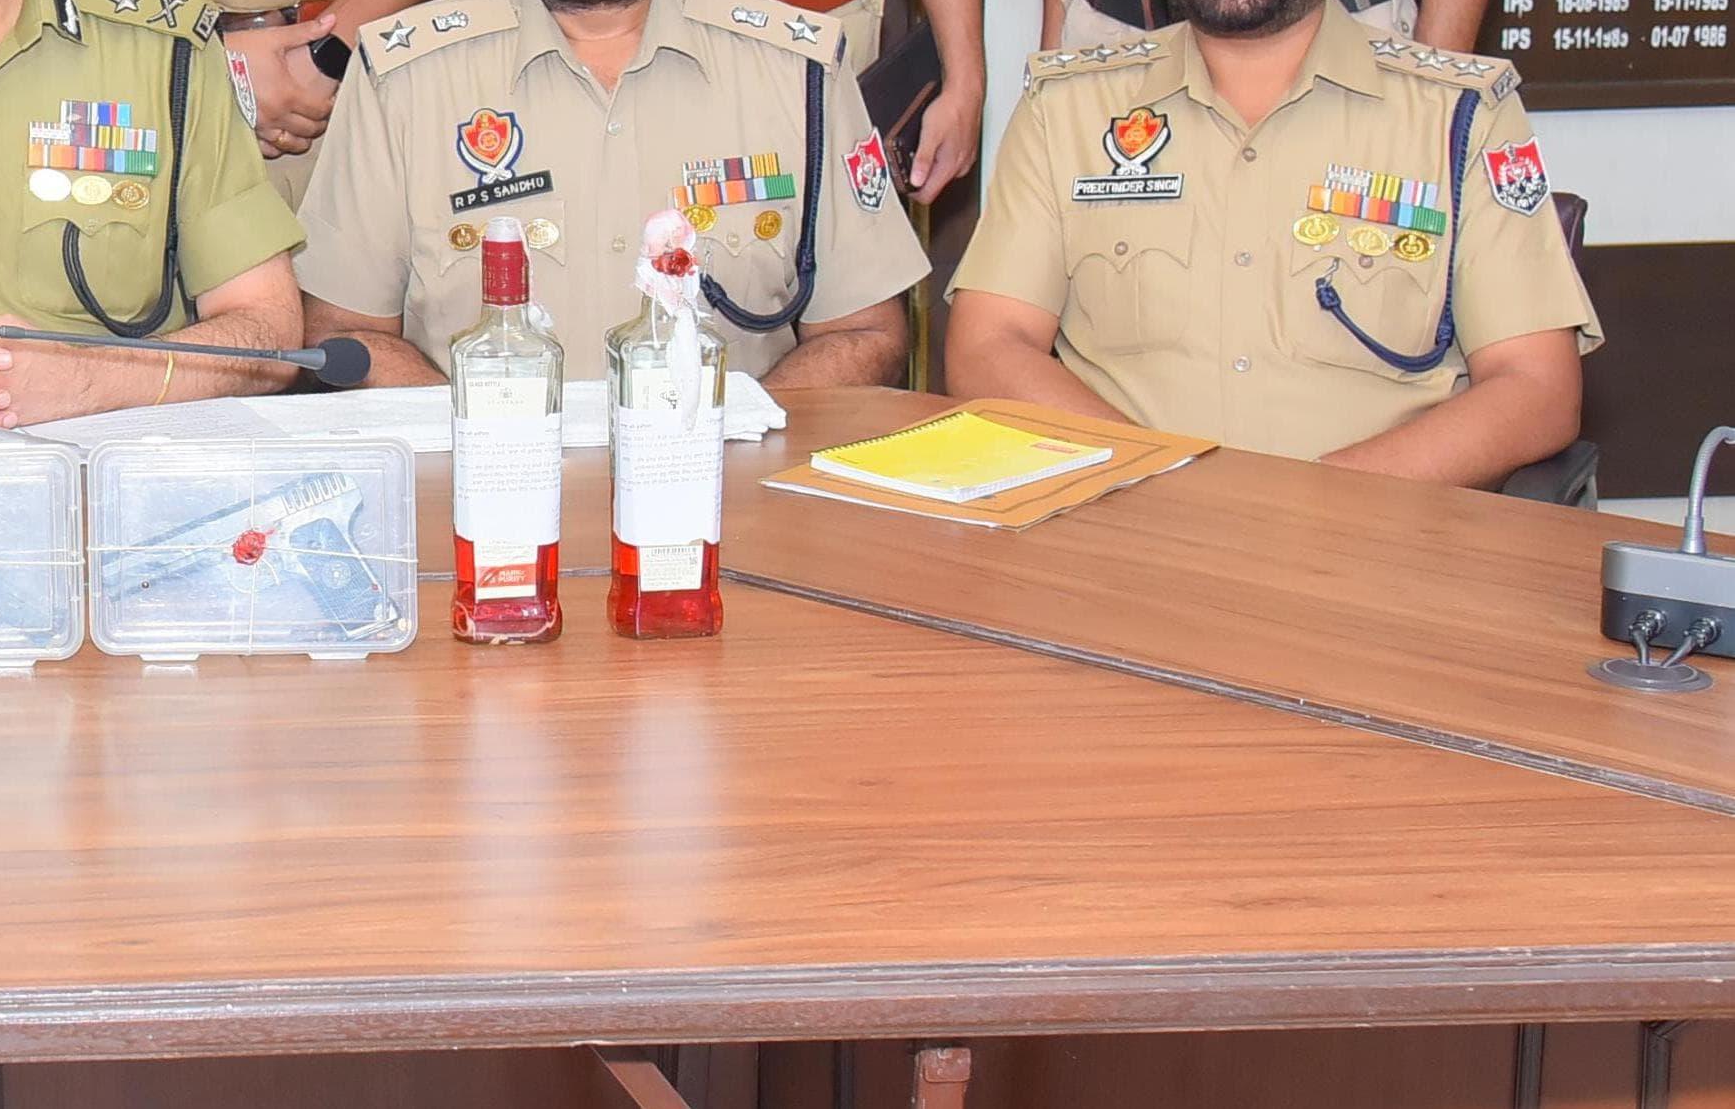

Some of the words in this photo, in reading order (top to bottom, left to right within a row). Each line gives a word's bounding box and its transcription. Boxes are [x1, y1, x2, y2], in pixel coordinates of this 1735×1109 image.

[1501, 28, 1531, 50] IPS
[455, 196, 465, 208] R
[467, 193, 477, 205] P
[480, 190, 490, 202] S
[493, 176, 545, 198] SANDHU
[1145, 179, 1178, 192] SINGH
